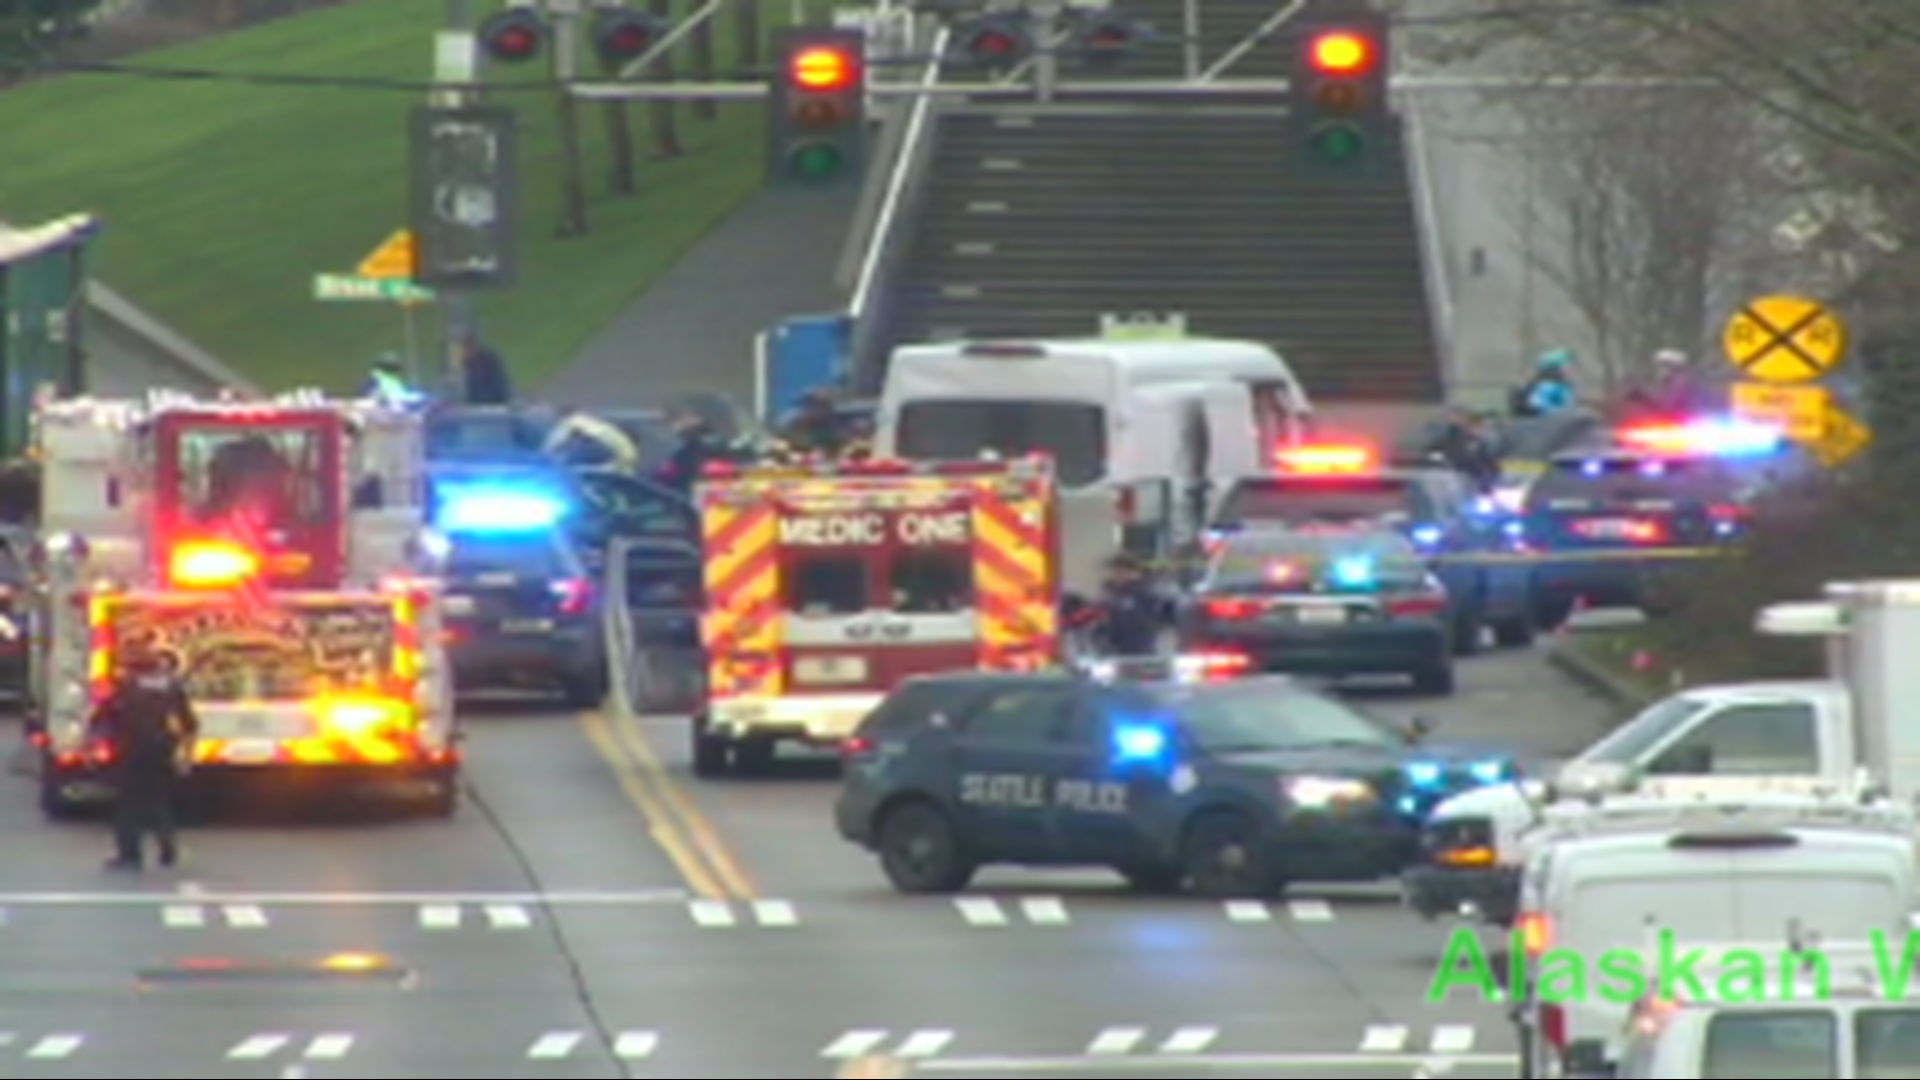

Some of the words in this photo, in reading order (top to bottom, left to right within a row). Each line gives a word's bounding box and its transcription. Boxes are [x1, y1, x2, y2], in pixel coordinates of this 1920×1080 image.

[779, 514, 885, 545] MEDIC
[897, 513, 969, 545] ONE
[960, 774, 1046, 807] SEATTLE
[1055, 779, 1128, 813] POLICE
